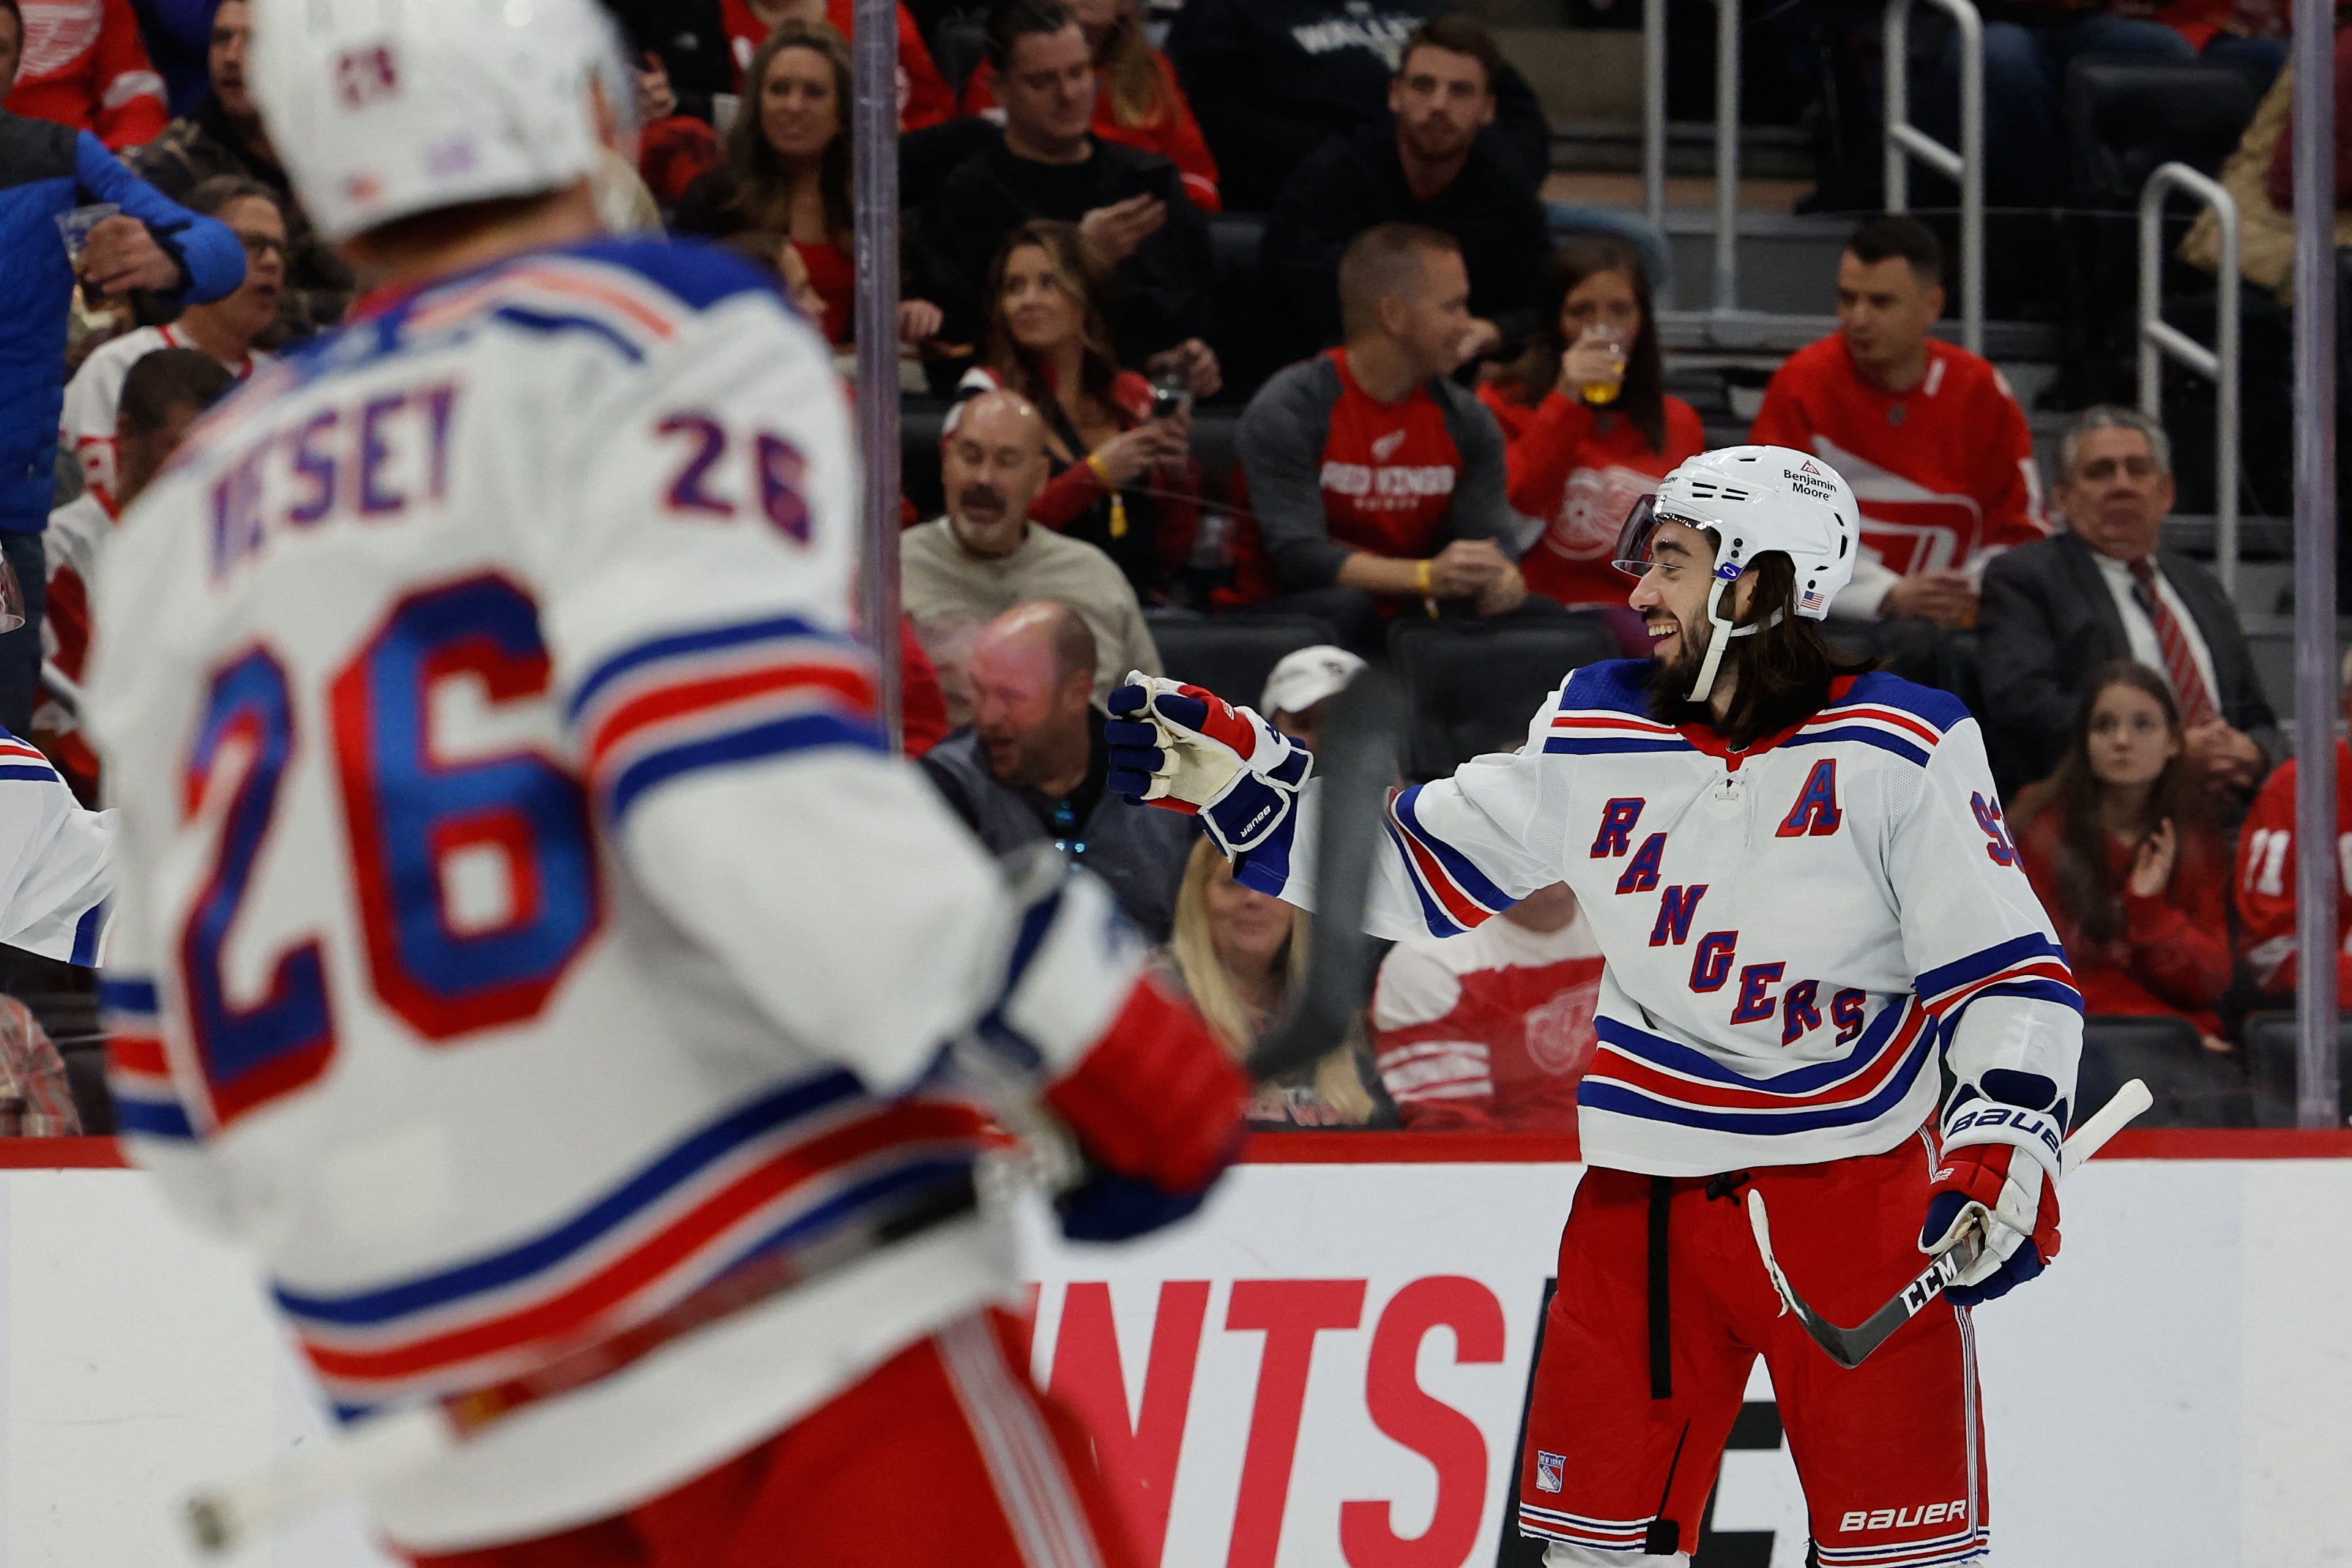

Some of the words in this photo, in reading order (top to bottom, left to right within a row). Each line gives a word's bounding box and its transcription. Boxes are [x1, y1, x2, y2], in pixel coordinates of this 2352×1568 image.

[655, 410, 814, 546] 26
[1784, 469, 1837, 493] Benjamin
[1793, 482, 1830, 501] Moore
[1775, 758, 1842, 837] A
[182, 575, 604, 1129] 26
[1590, 797, 1867, 1048] RANGERS
[1899, 1252, 1958, 1318] CCM
[1025, 1274, 1505, 1568] NTS
